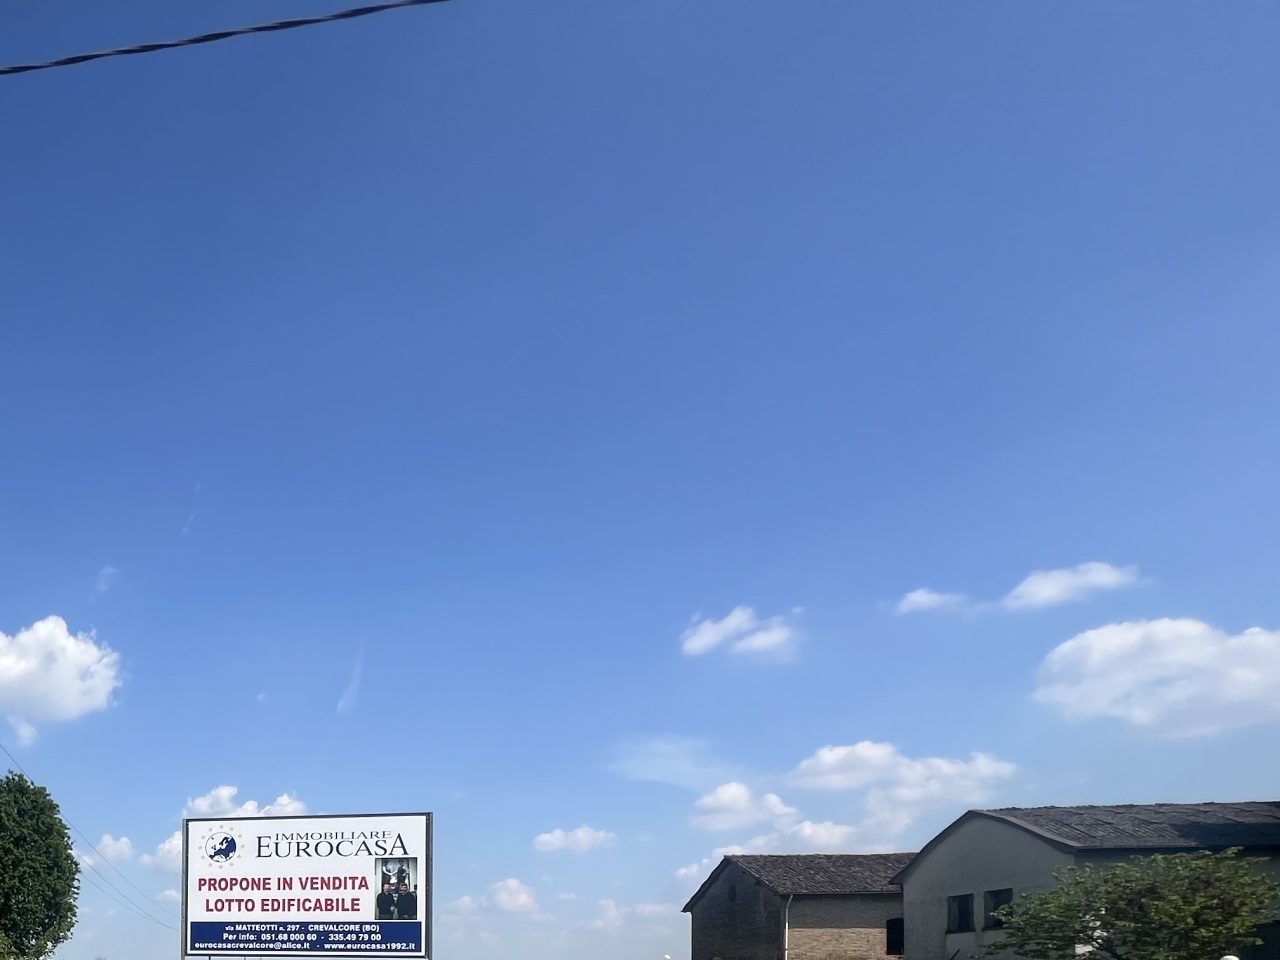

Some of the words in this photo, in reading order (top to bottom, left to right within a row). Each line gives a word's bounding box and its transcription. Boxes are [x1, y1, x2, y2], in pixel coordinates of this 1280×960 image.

[275, 831, 392, 841] IMMOBILIARE
[256, 833, 409, 858] EUROCASA
[198, 877, 271, 891] PROPONE
[277, 877, 293, 891] IN
[298, 876, 369, 891] VENDITA
[205, 898, 255, 912] LOTTO
[261, 898, 361, 912] EDIFICABILE
[362, 924, 380, 932] (BO)
[261, 933, 288, 941] 051.68
